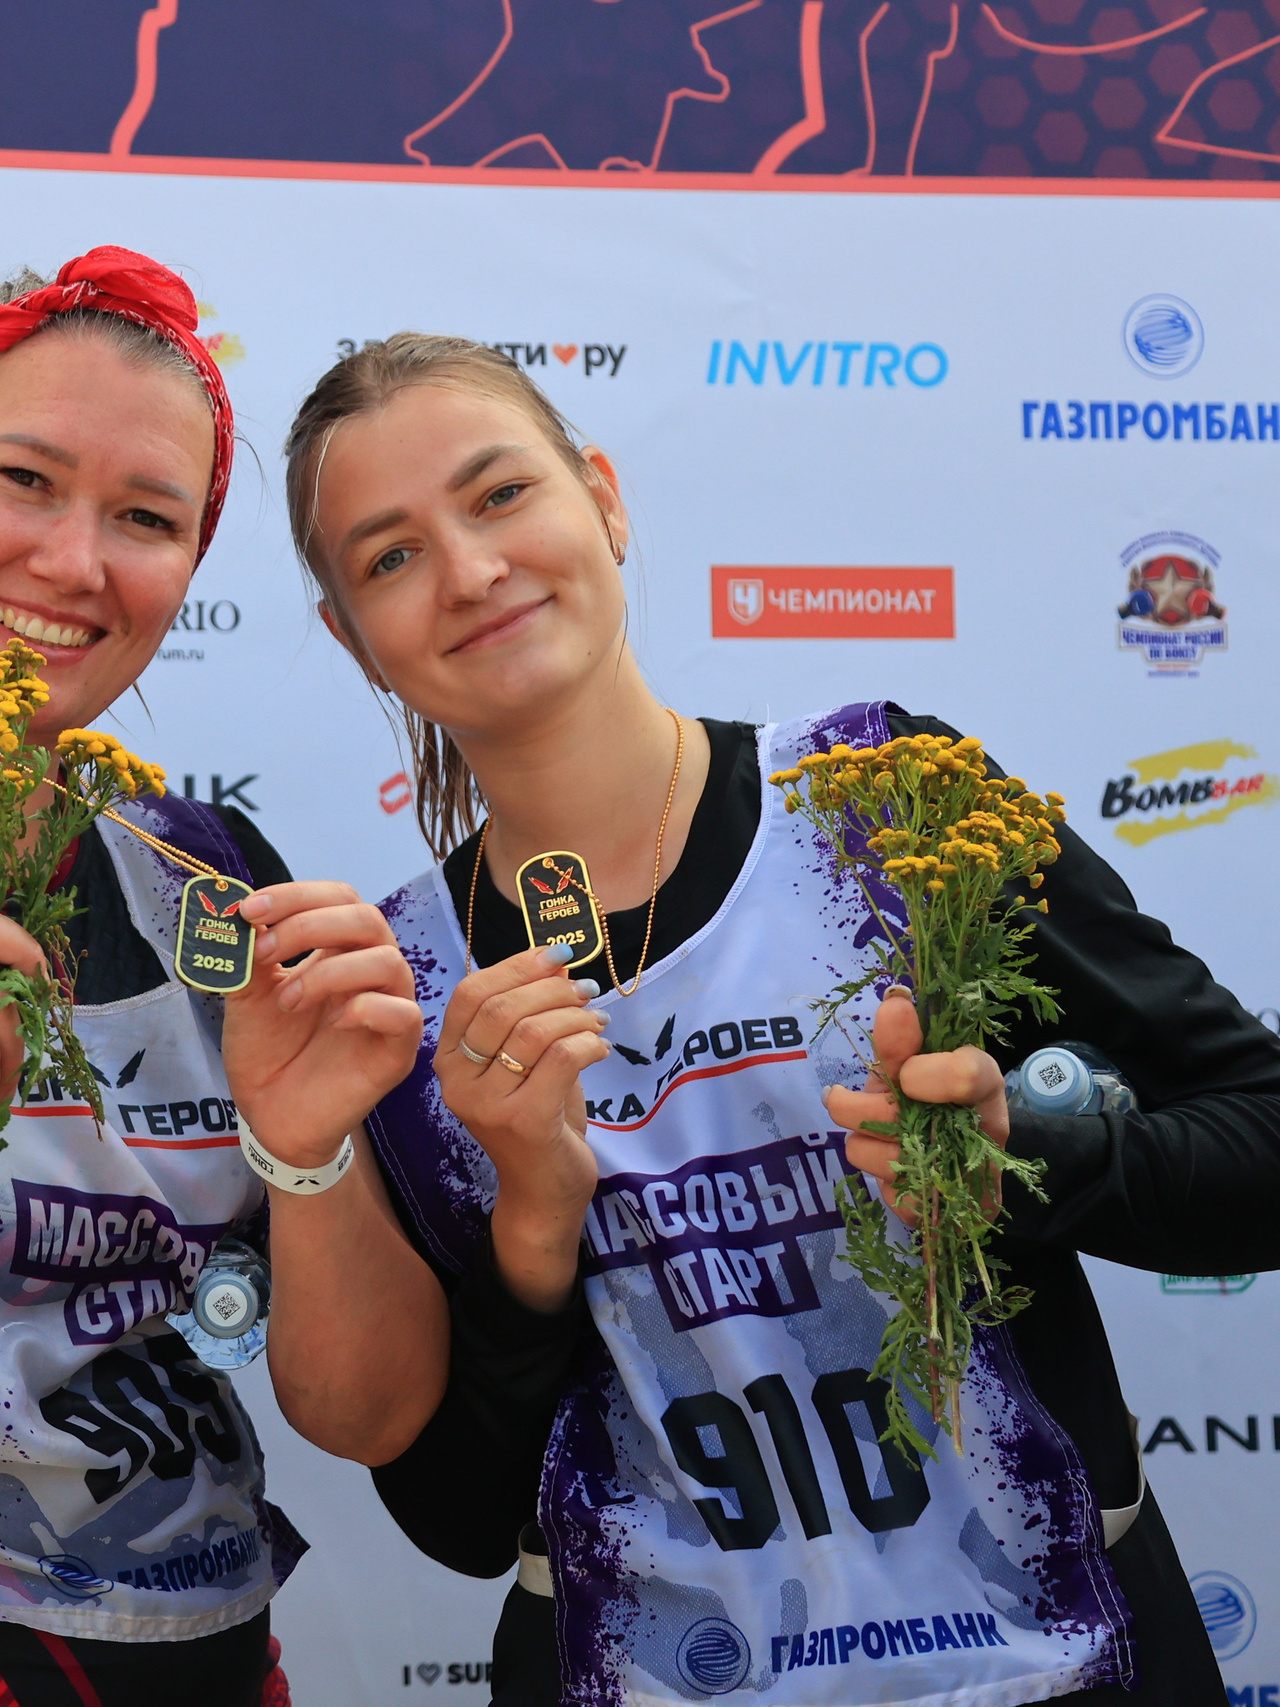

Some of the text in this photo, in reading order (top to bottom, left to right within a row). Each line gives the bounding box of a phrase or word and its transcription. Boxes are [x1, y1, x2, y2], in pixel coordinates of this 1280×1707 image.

[706, 340, 949, 388] INVITRO
[1023, 402, 1280, 441] ГАЗПРОМБАН
[769, 588, 937, 613] ЧЕМПИОНАТ
[539, 894, 576, 910] ГОНКА
[539, 905, 581, 923] ГЕРОЕВ
[194, 929, 239, 945] ГЕРОЕВ
[199, 917, 237, 932] ГОНКА
[192, 953, 235, 973] 2025
[27, 1198, 218, 1294] МАССОВ
[663, 1241, 796, 1319] СТАРТ
[39, 1332, 241, 1504] 905
[1143, 1414, 1280, 1453] AN
[660, 1367, 931, 1552] 910
[118, 1525, 261, 1592] ГАЗПРОМБАНК
[771, 1613, 1010, 1673] ГАЗПРОМБАНК
